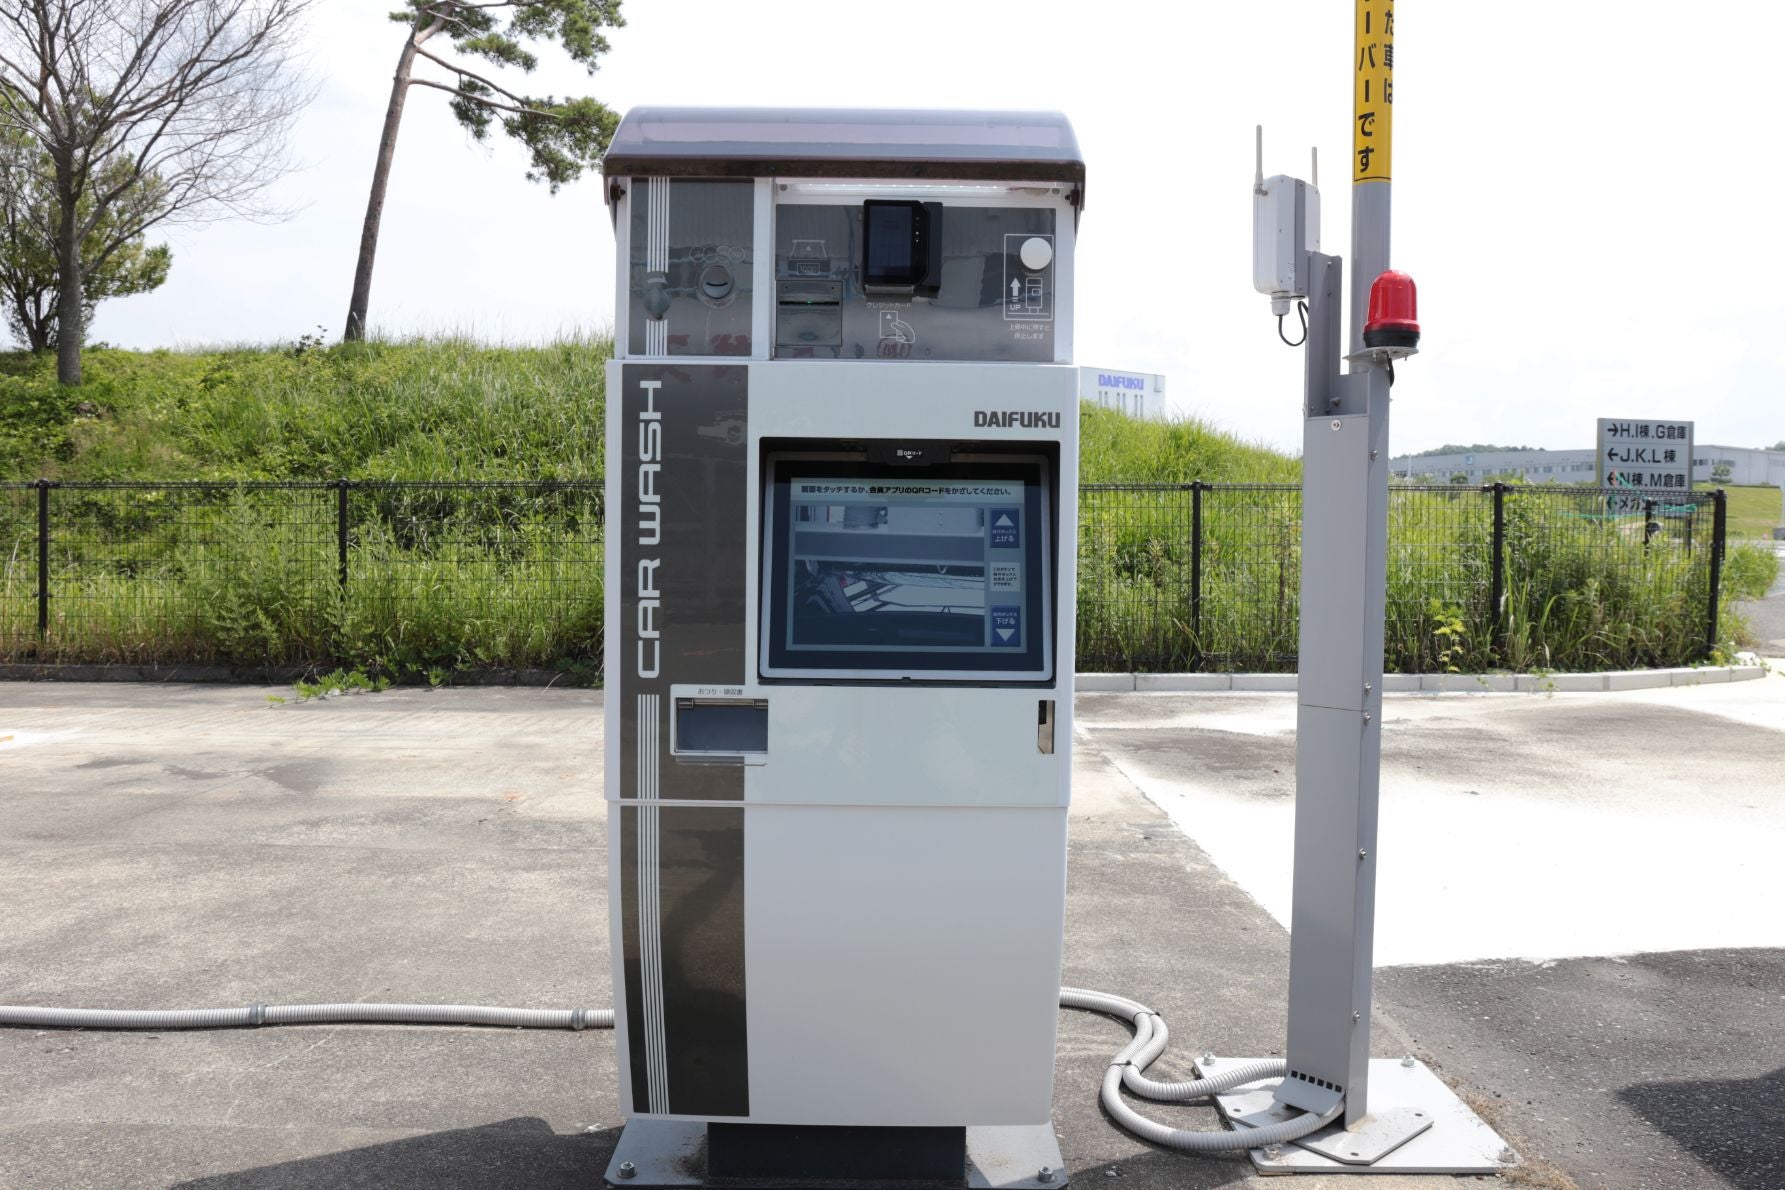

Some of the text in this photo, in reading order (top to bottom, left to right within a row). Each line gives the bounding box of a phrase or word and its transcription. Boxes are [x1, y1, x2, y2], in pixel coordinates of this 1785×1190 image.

[1383, 0, 1395, 105] た車は
[1358, 0, 1377, 173] ーバーです
[1098, 374, 1144, 390] DAIFUKU
[974, 411, 1061, 428] DAIFUKU
[801, 485, 1012, 496] 画面をタッチするか、会員アプリのQRコードをかざしてください。
[637, 380, 662, 679] CAR WASH
[994, 535, 1014, 543] 上げる
[995, 617, 1015, 625] 下げる
